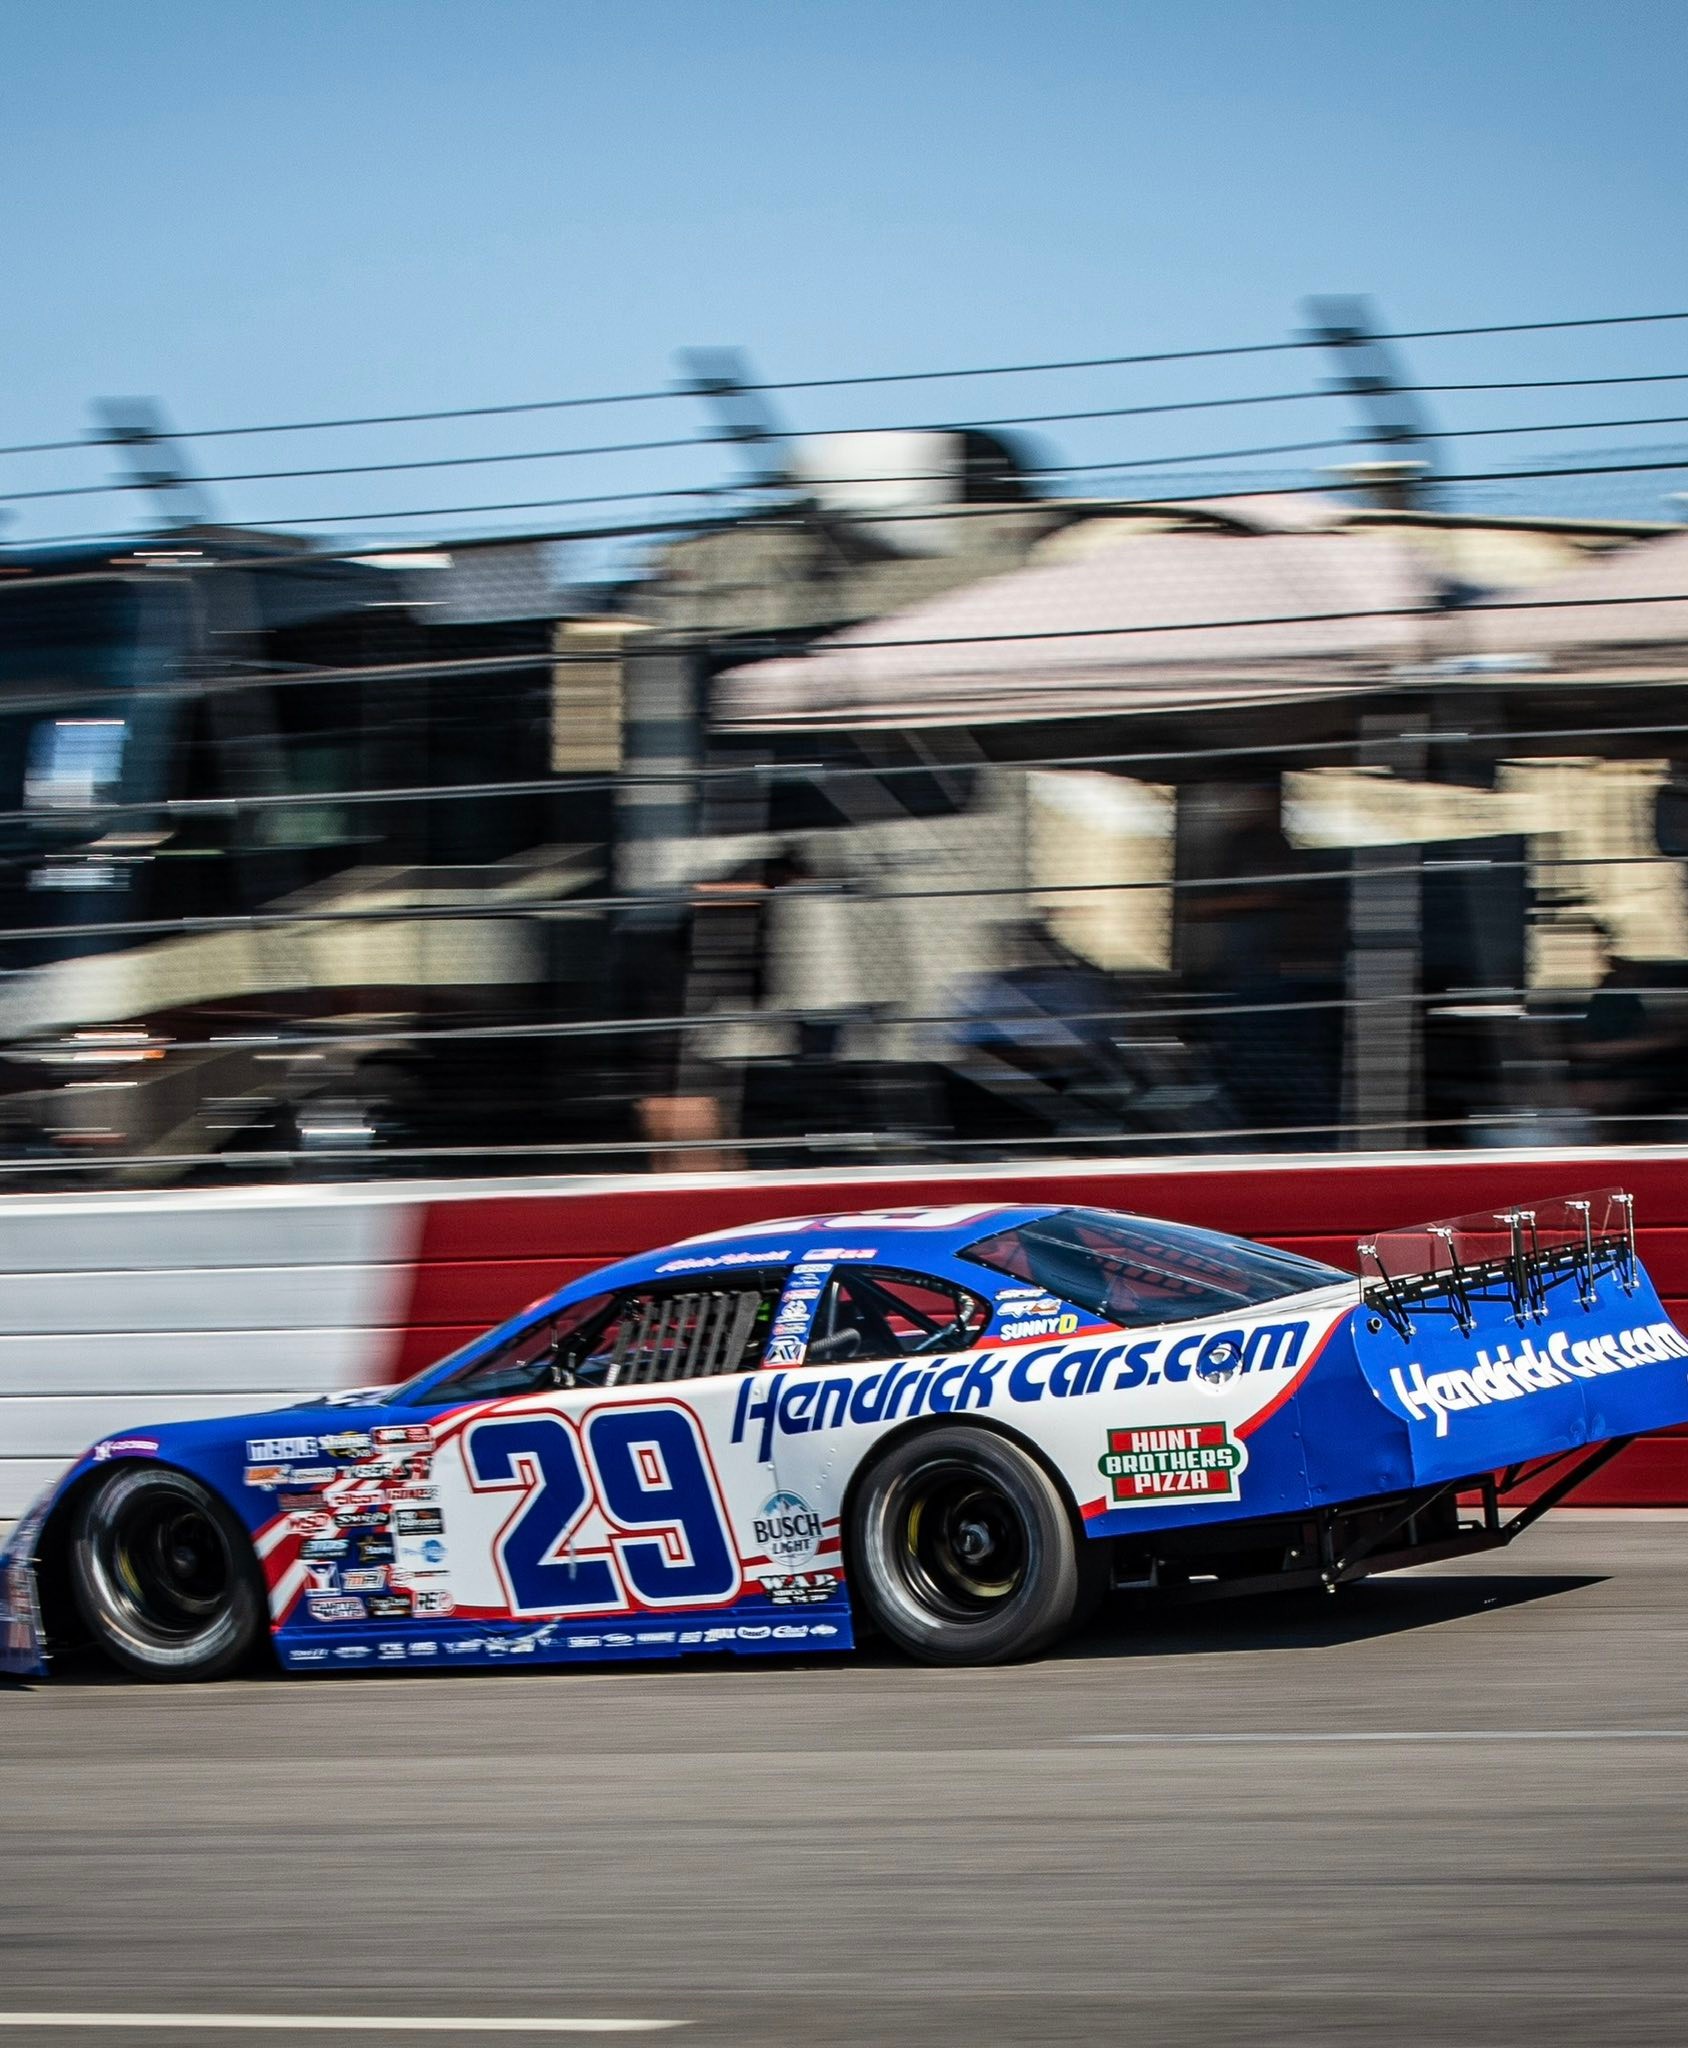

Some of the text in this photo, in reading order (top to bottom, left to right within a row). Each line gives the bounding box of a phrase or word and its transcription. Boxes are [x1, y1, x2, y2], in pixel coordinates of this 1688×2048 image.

[1000, 1313, 1078, 1341] SUNNYD
[1131, 1428, 1202, 1453] HUNT
[1105, 1448, 1234, 1475] BROTHERS
[1134, 1469, 1209, 1494] PIZZA
[465, 1402, 741, 1616] 29
[753, 1512, 823, 1543] BUSCH
[772, 1538, 811, 1555] LIGHT
